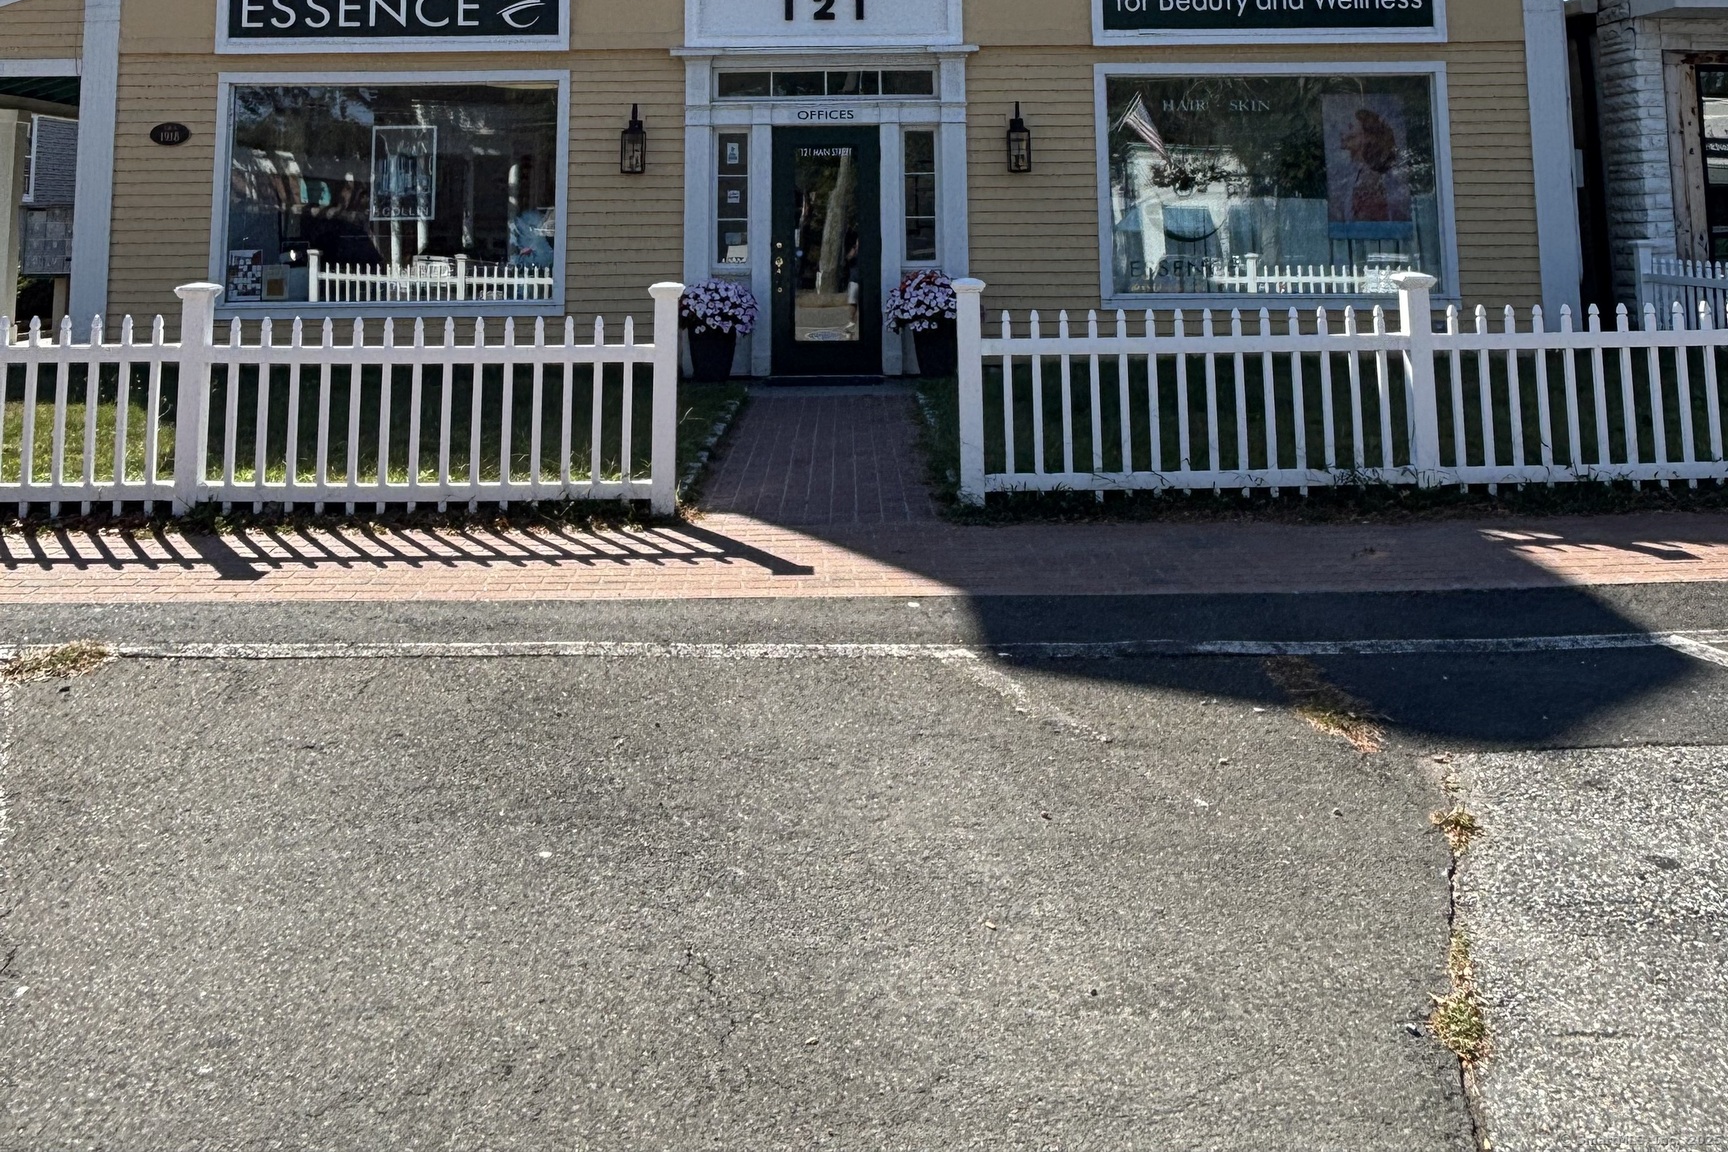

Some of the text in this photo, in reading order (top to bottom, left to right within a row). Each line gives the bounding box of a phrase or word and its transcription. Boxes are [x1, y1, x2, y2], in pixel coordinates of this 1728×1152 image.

[1163, 99, 1271, 112] HAIR SKIN
[797, 110, 854, 120] OFFICES
